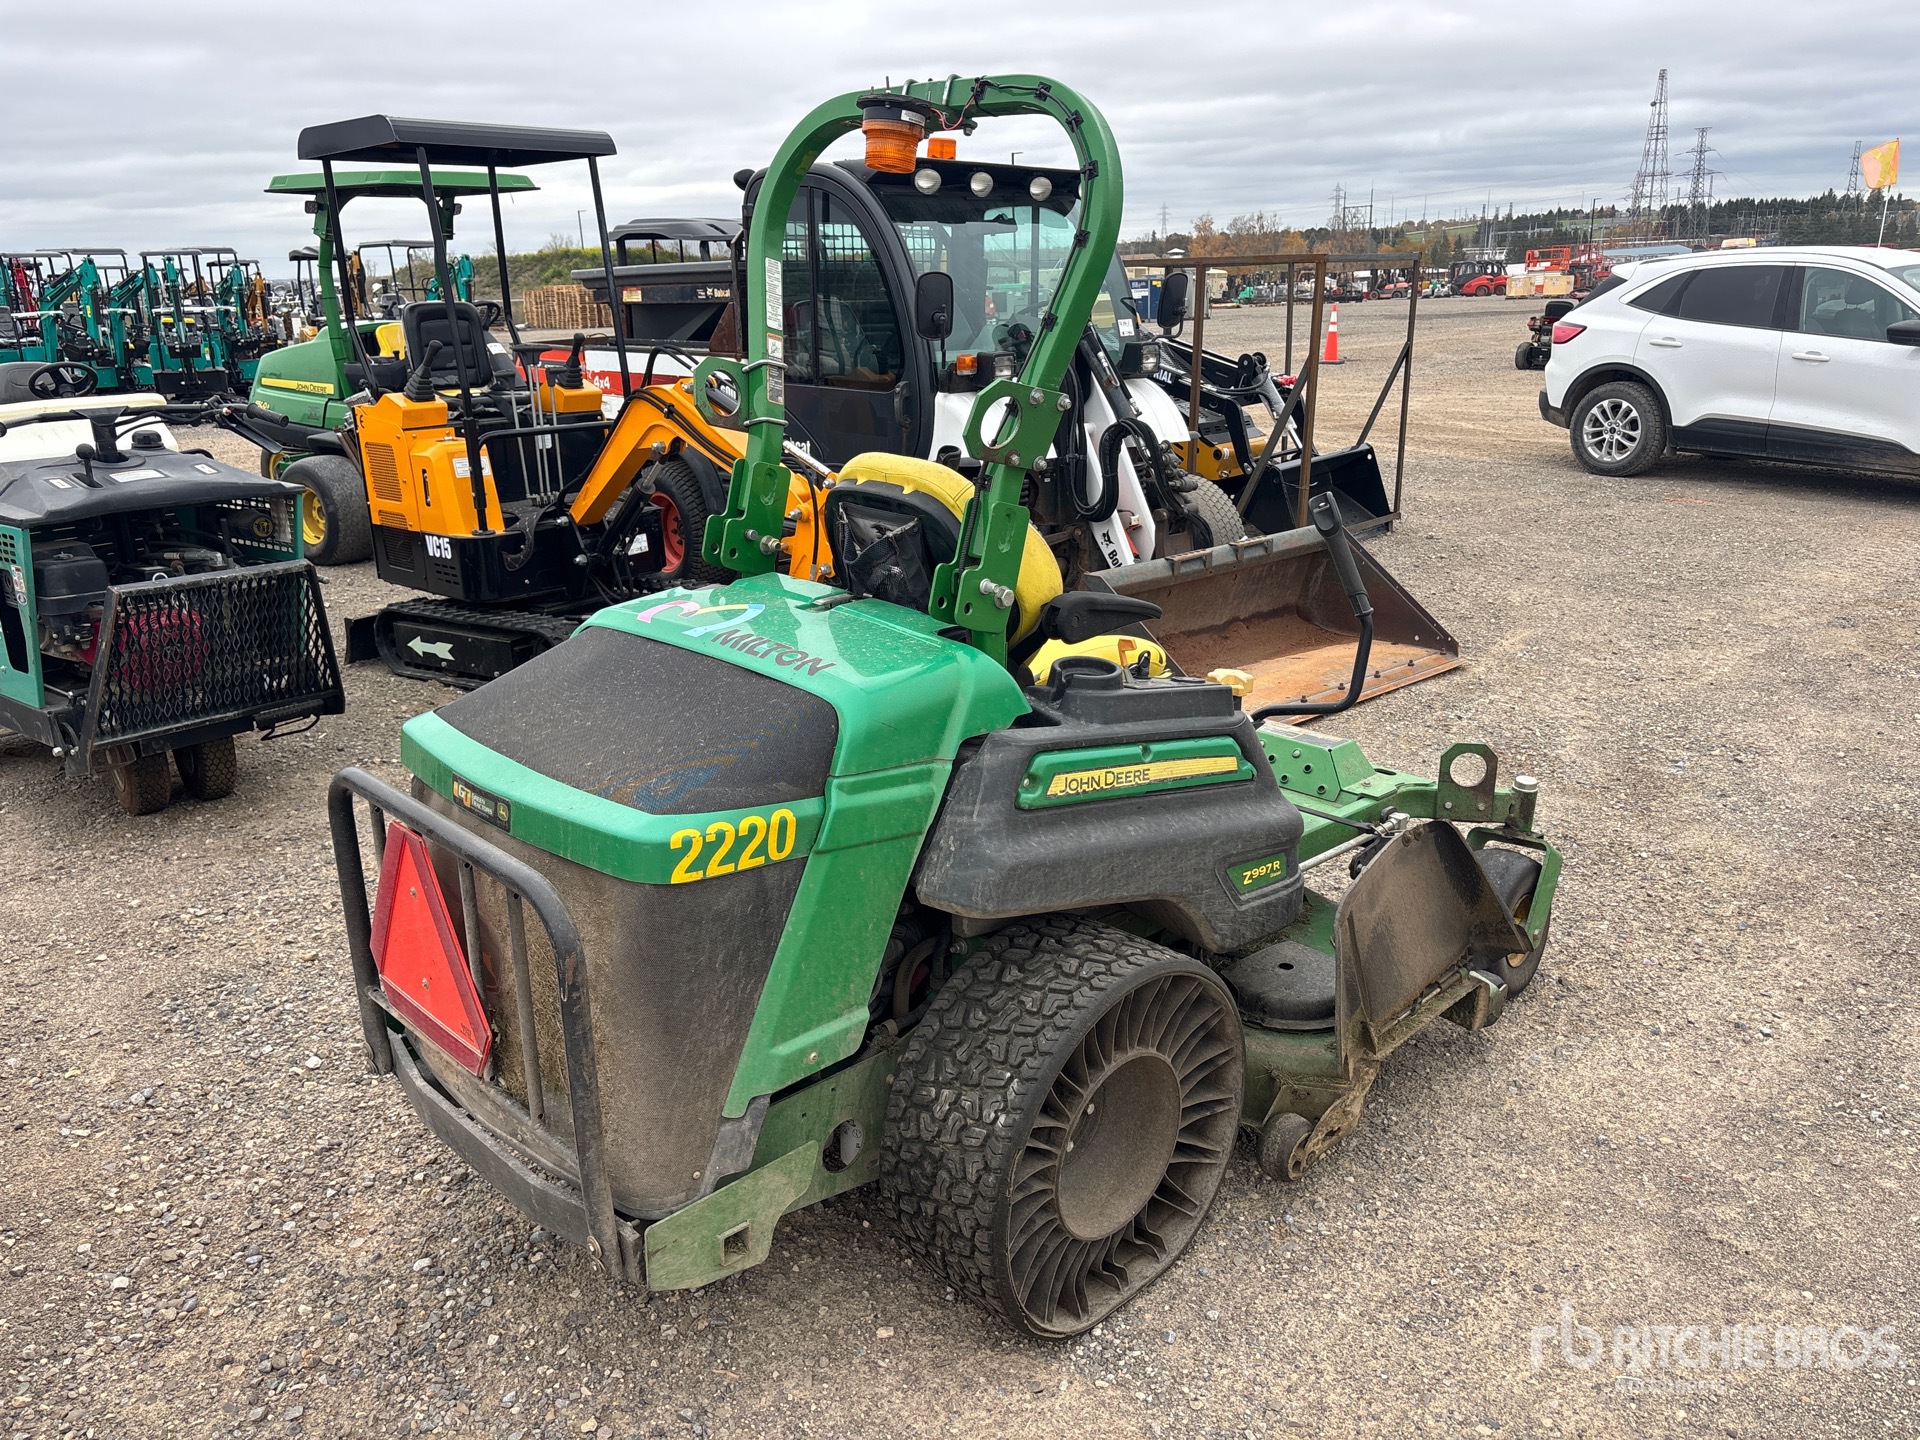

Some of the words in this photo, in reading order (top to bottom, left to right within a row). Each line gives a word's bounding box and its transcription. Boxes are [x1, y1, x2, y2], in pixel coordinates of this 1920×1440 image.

[593, 375, 611, 389] 4x4
[425, 535, 452, 560] VC15
[711, 628, 836, 677] MILTON
[1060, 774, 1101, 796] JOHN
[1104, 768, 1150, 788] DEERE
[670, 808, 797, 884] 2220
